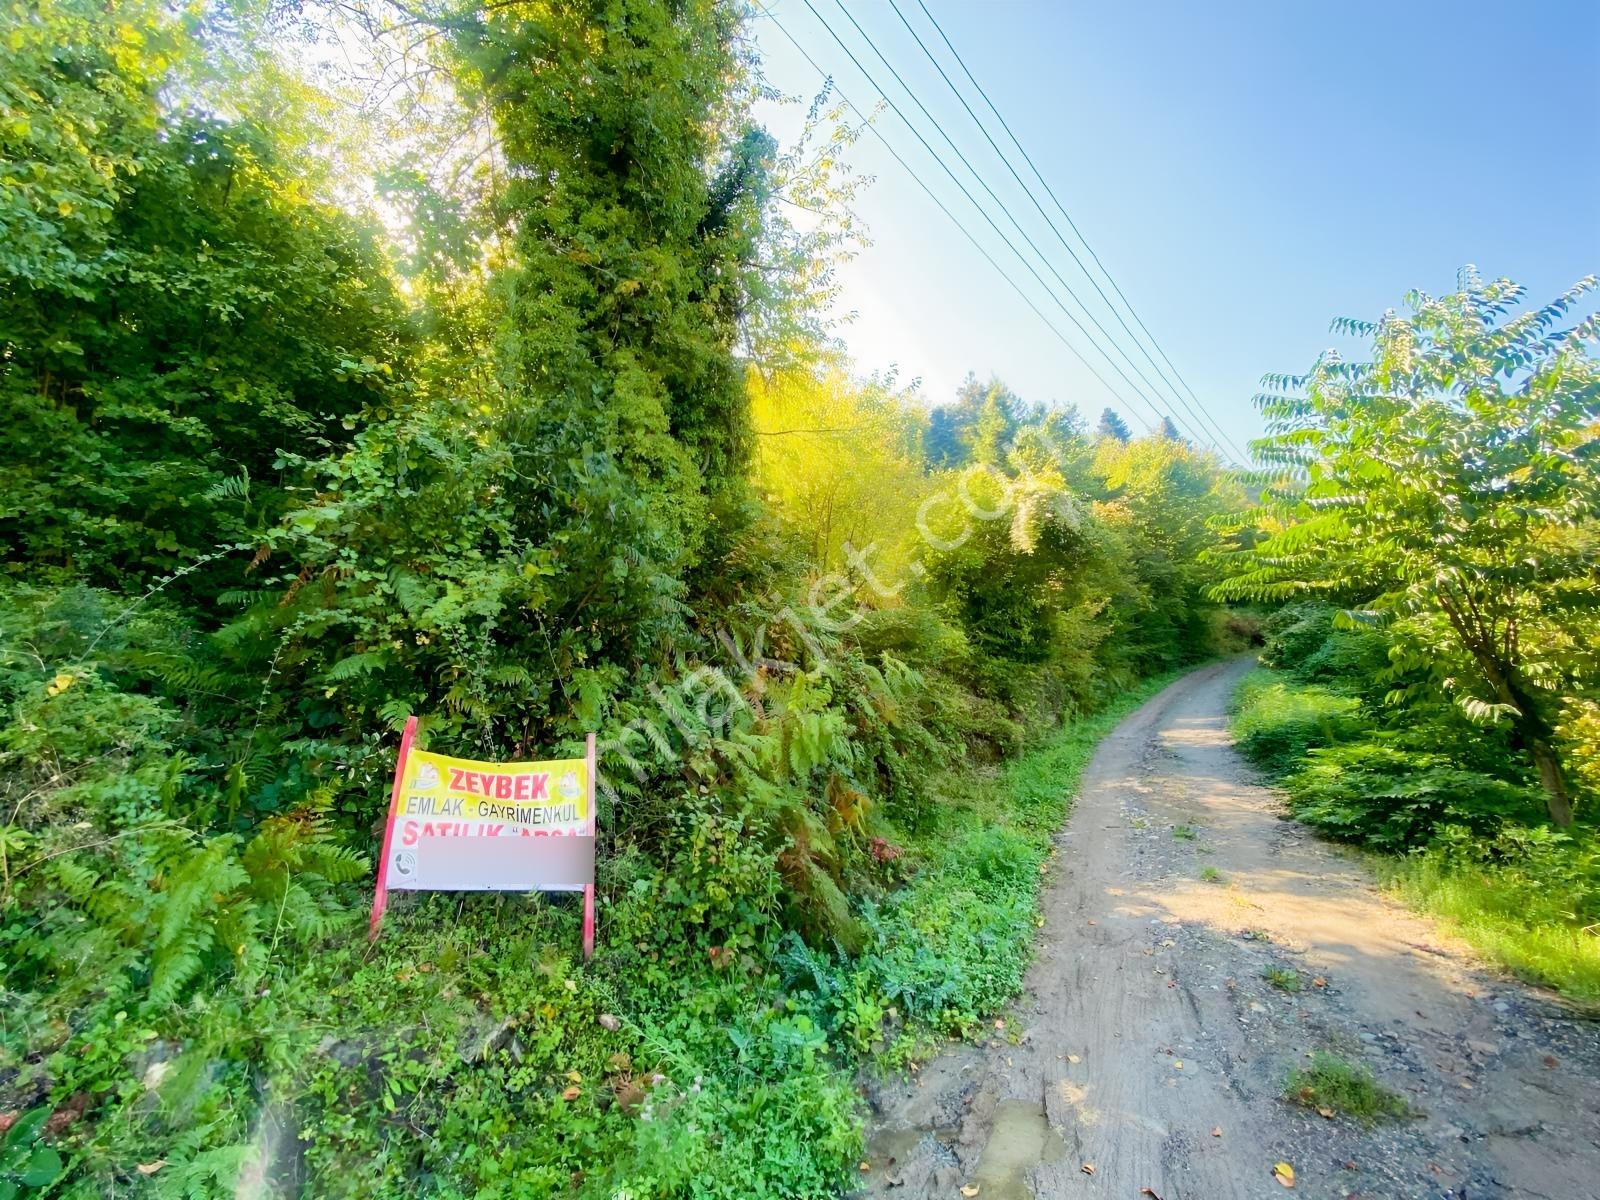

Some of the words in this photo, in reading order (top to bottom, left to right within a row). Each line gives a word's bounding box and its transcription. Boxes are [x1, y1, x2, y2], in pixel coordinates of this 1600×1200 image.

[449, 768, 549, 800] ZEYBEK
[406, 796, 464, 816] EMLAK
[478, 801, 580, 825] GAYRİMENKUL
